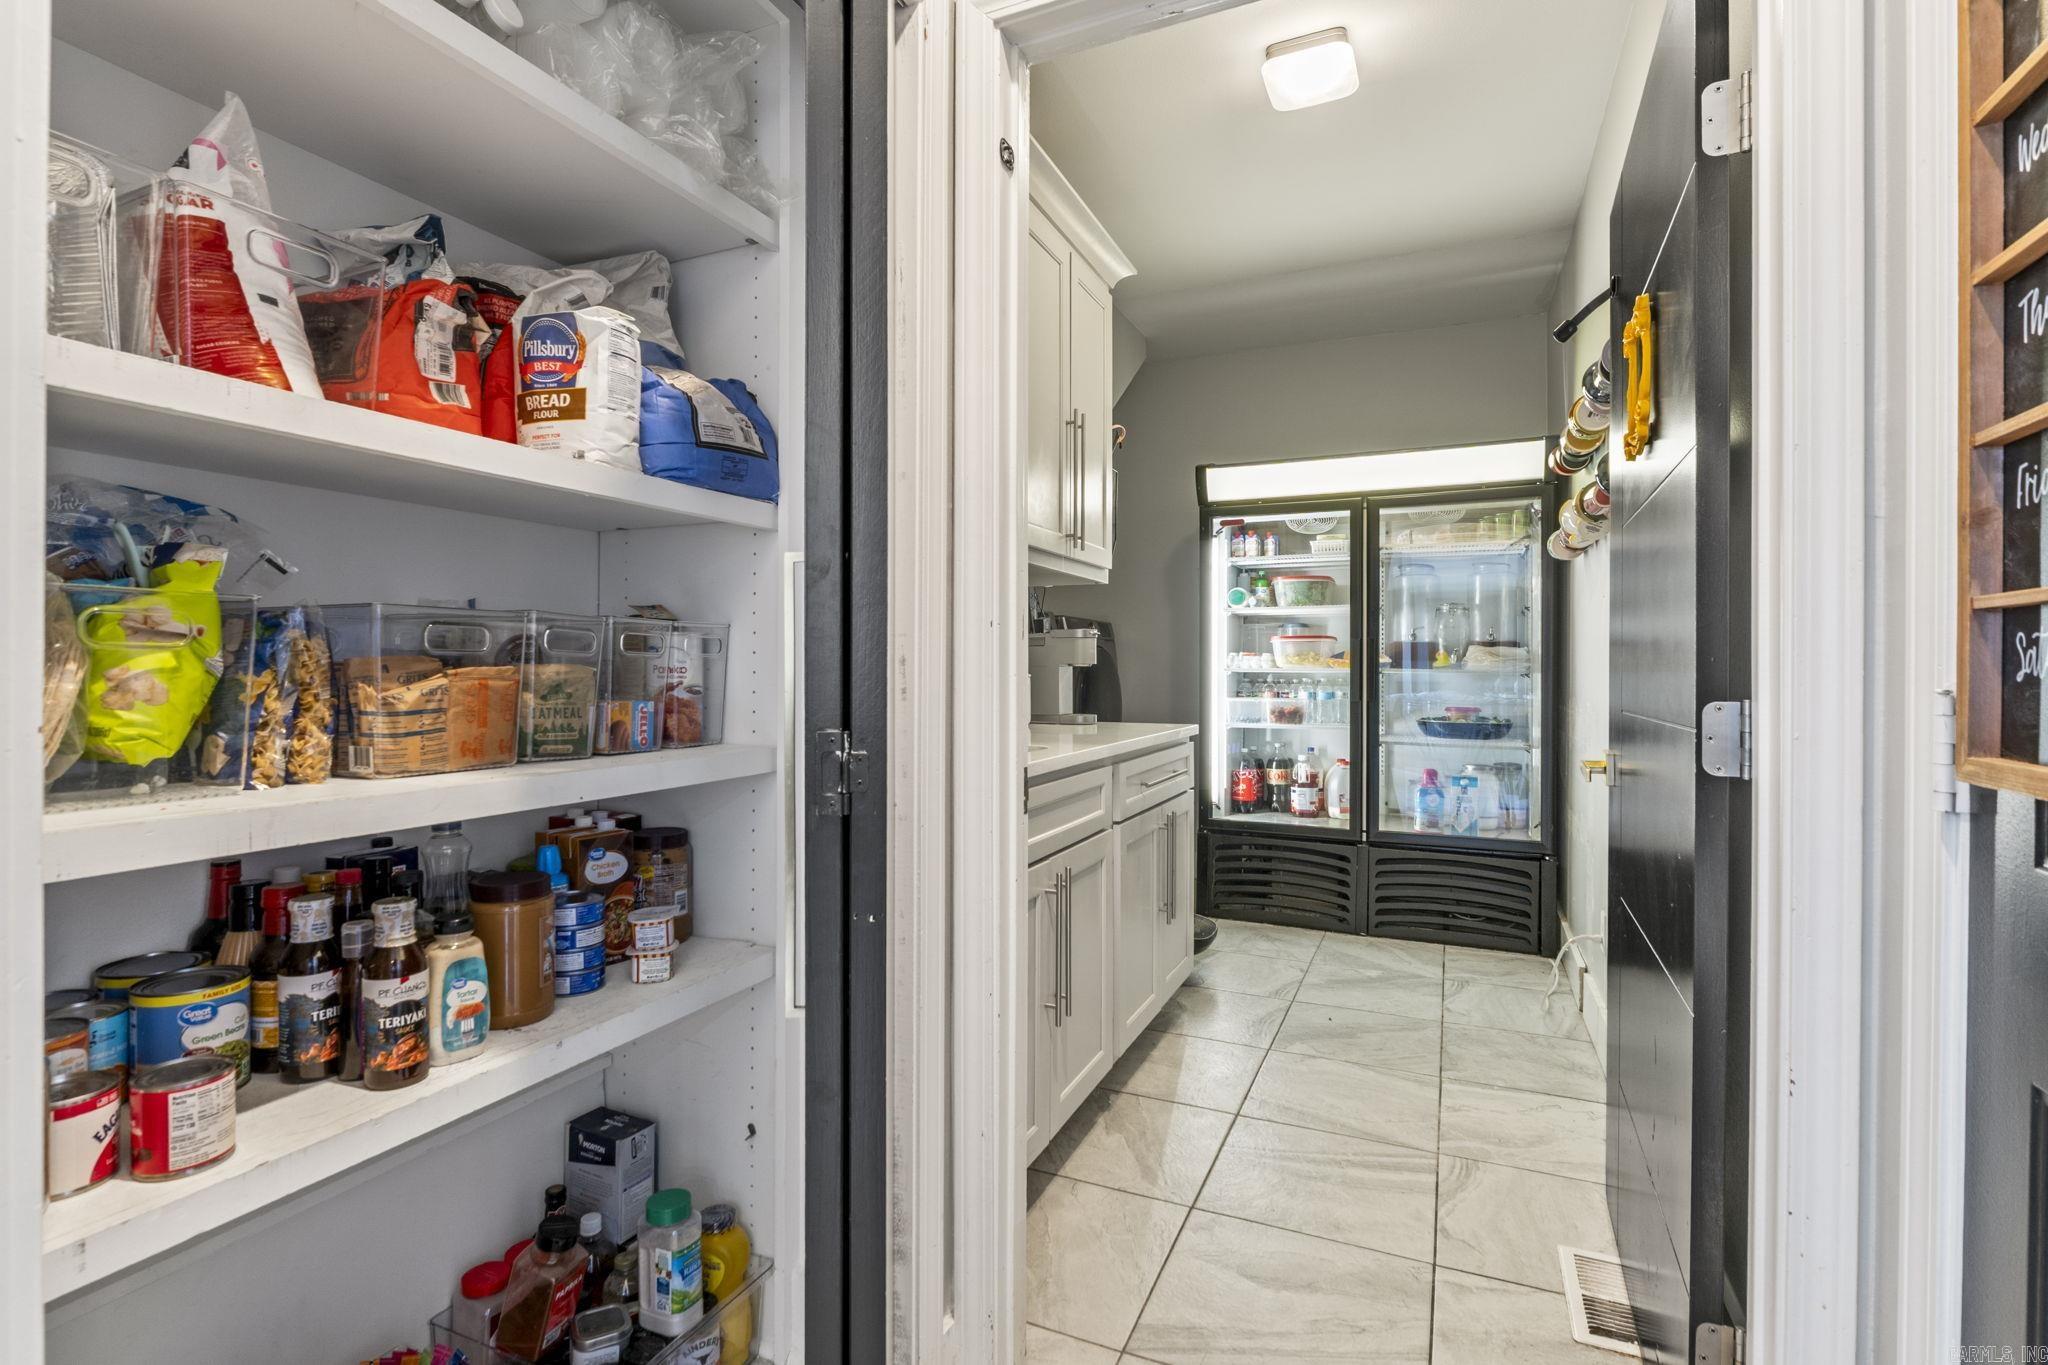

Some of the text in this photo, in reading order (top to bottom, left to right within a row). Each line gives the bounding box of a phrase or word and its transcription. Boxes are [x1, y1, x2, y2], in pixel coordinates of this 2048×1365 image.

[524, 339, 576, 360] Pillsbury
[533, 361, 562, 372] BEST
[525, 393, 571, 411] BREAD
[533, 410, 560, 420] FLOUR
[202, 987, 230, 1000] FAMILY
[182, 1006, 213, 1020] Great
[378, 1007, 427, 1030] TERIYAKI
[191, 1031, 223, 1045] Green
